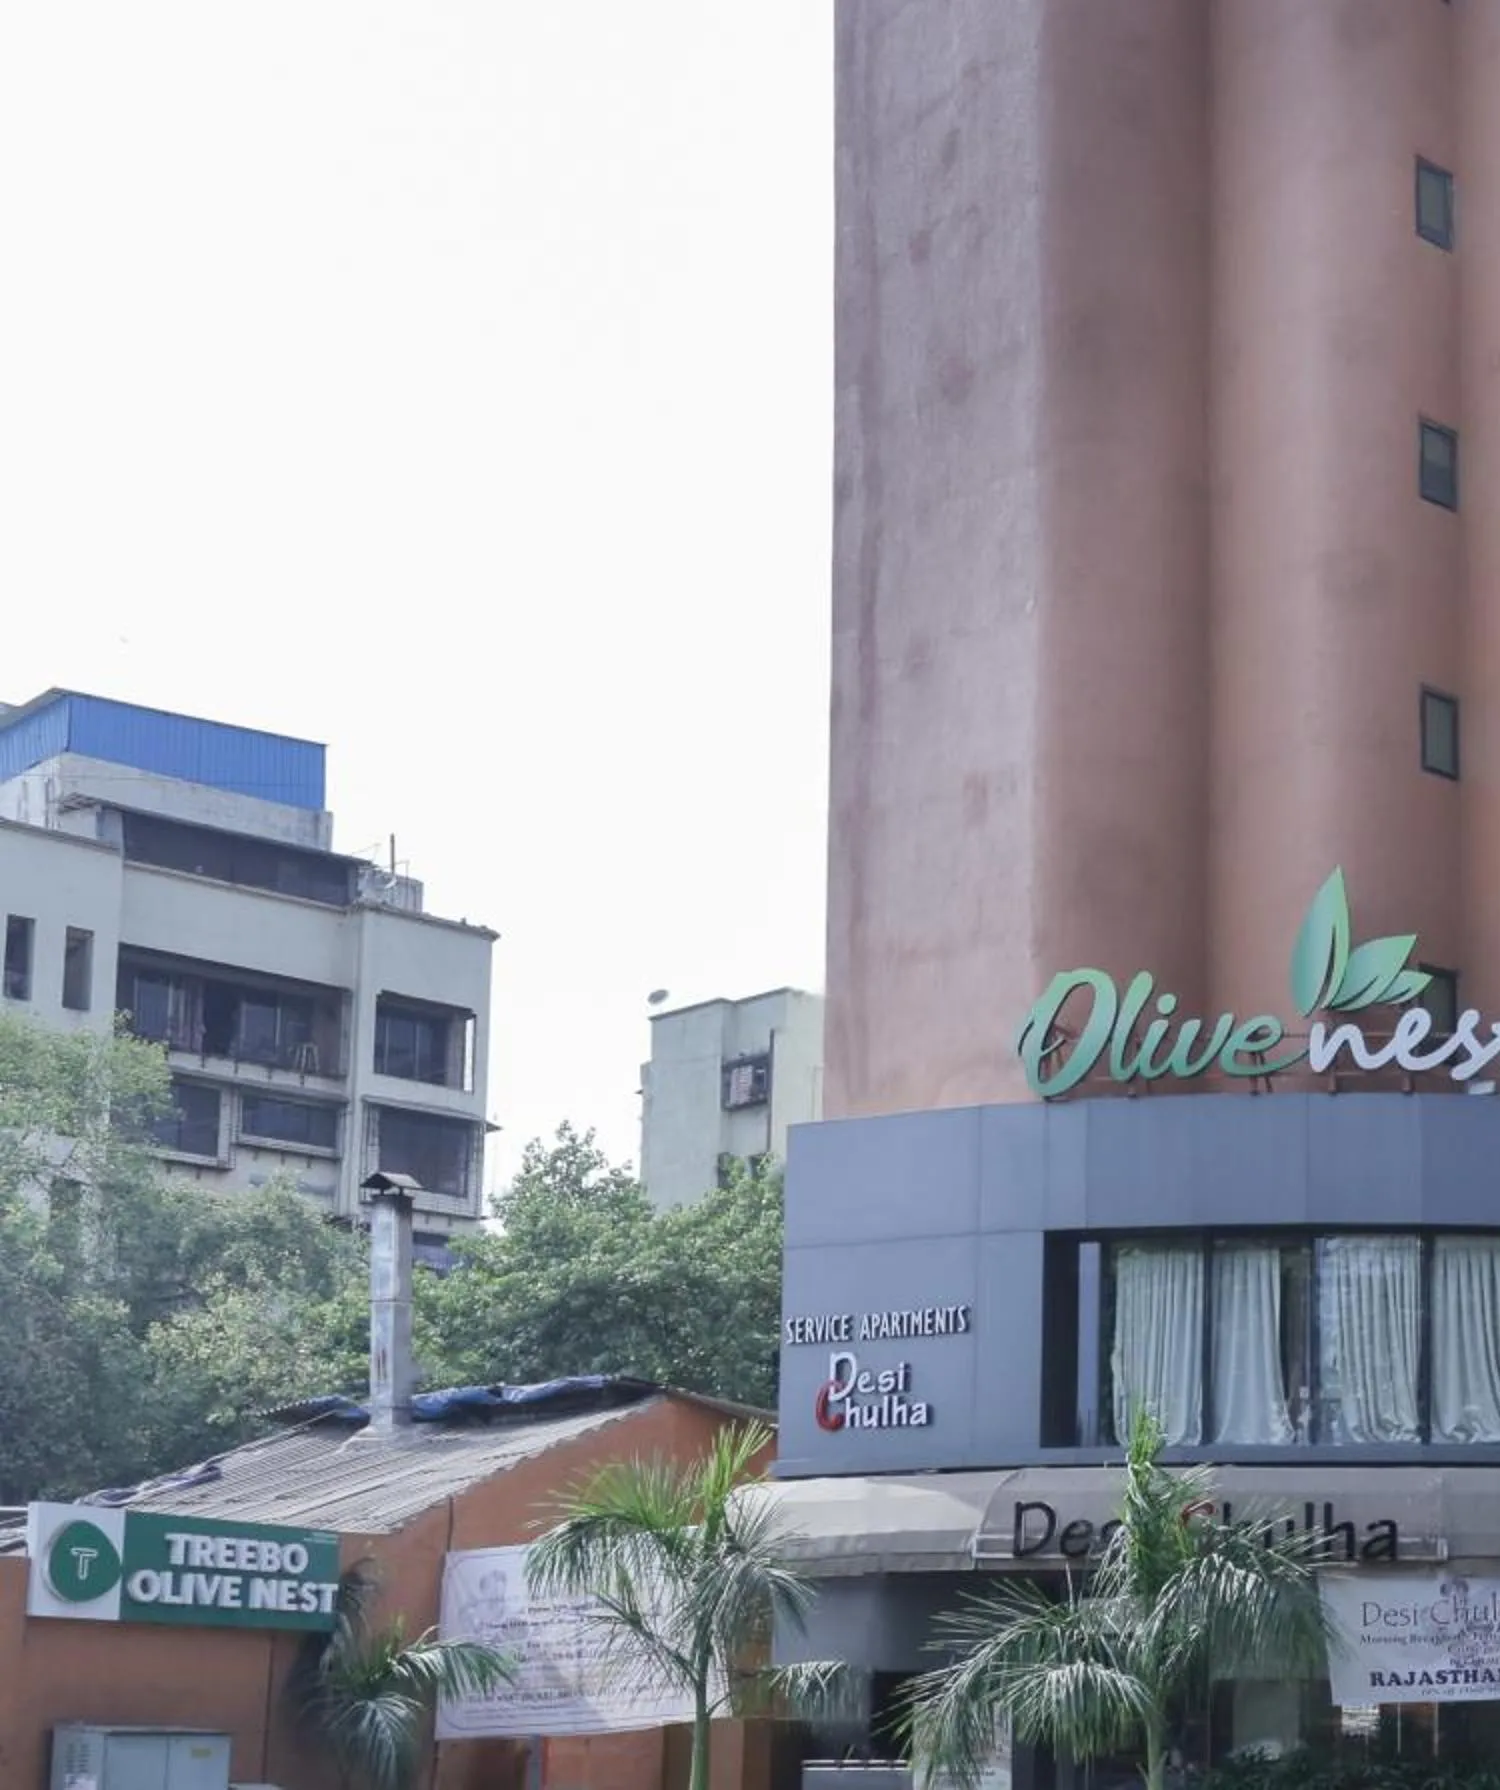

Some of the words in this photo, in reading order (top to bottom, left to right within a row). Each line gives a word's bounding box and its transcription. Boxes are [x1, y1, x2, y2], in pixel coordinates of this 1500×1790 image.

[1018, 967, 1309, 1098] Olive
[786, 1315, 851, 1344] SERVICE
[859, 1305, 967, 1341] APARTMENTS
[829, 1352, 906, 1401] Desi
[816, 1379, 928, 1432] Chulha
[1013, 1501, 1142, 1558] De
[165, 1533, 309, 1574] TREEBO
[128, 1569, 242, 1608] OLIVE
[249, 1577, 339, 1613] NEST
[1362, 1601, 1418, 1627] Desi
